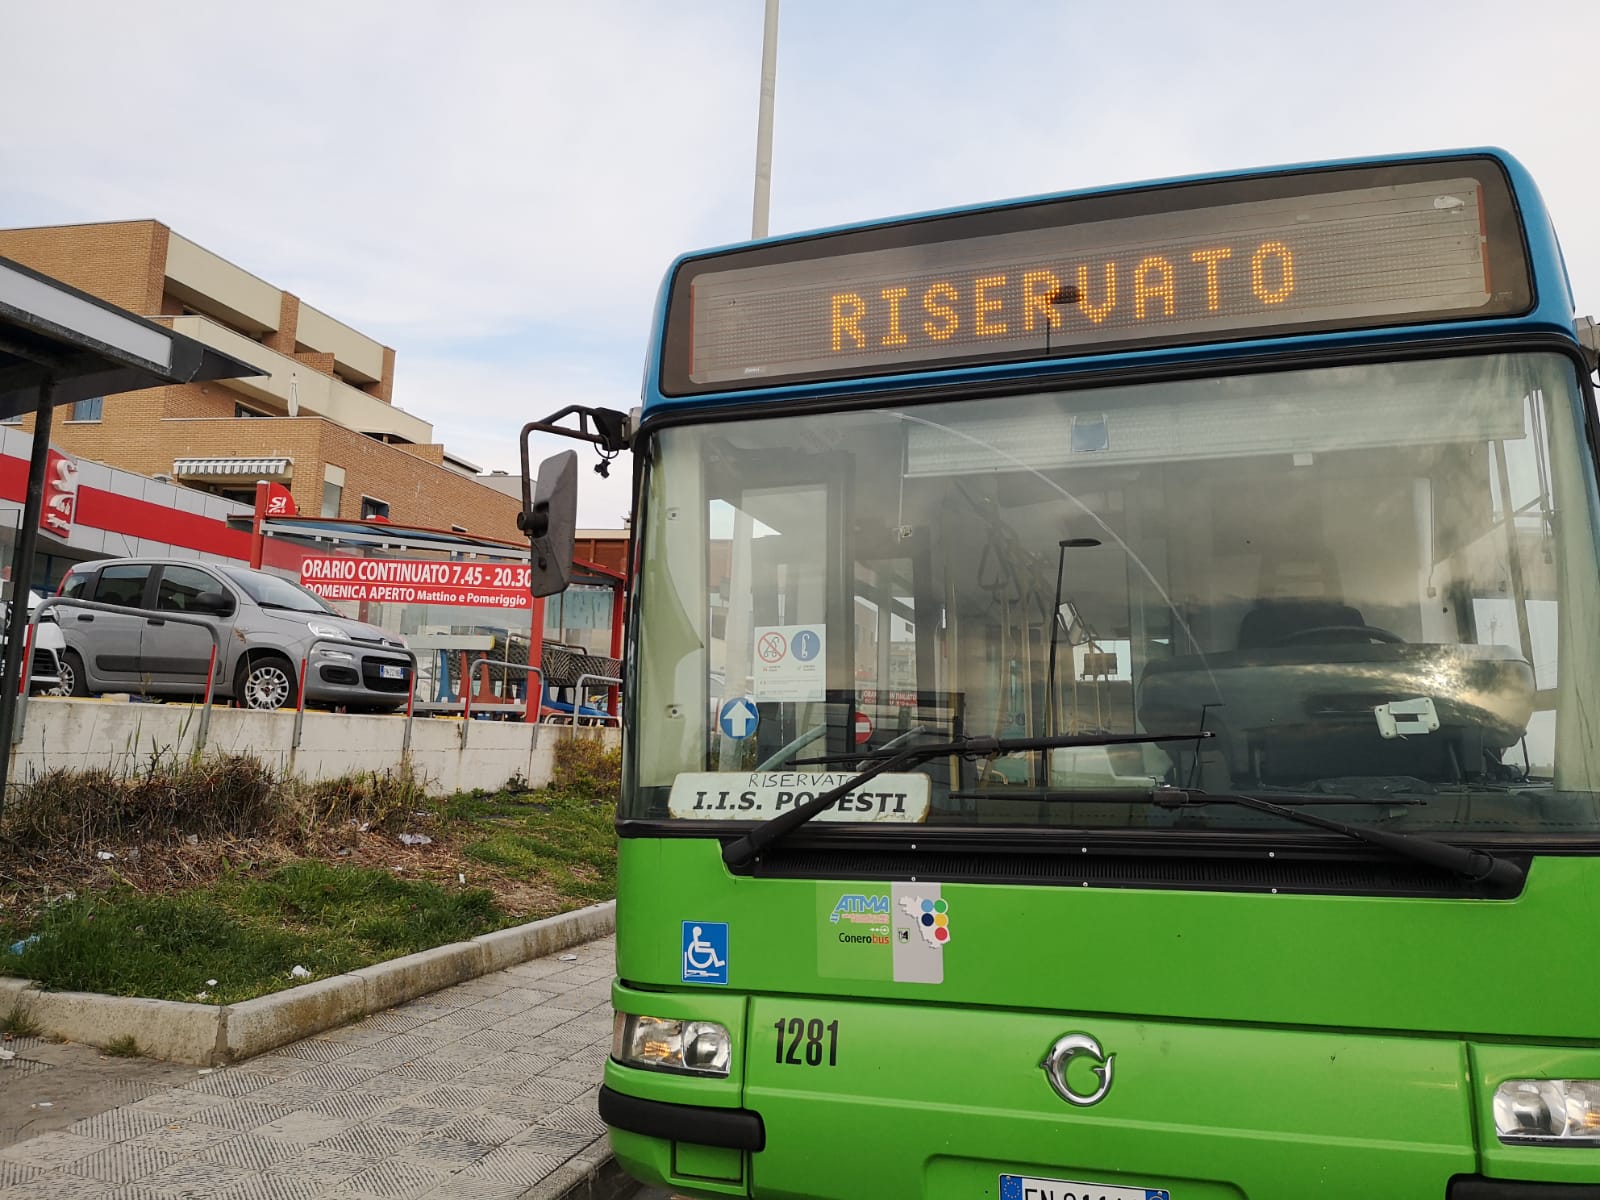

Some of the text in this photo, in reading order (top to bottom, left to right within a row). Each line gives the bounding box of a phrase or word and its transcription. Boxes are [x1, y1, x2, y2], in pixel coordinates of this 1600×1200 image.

[831, 240, 1295, 352] RISERVATO
[302, 559, 356, 580] ORARIO
[358, 561, 450, 584] CONTINUATO
[452, 566, 483, 586] 7.45
[369, 586, 415, 601] APERTO
[417, 591, 457, 603] Mattino
[458, 594, 465, 602] e
[467, 593, 527, 609] Pomeriggio
[692, 791, 762, 810] I.I.S.
[832, 893, 890, 915] ATMA
[838, 932, 890, 945] Conerobus
[774, 1017, 839, 1067] 1281
